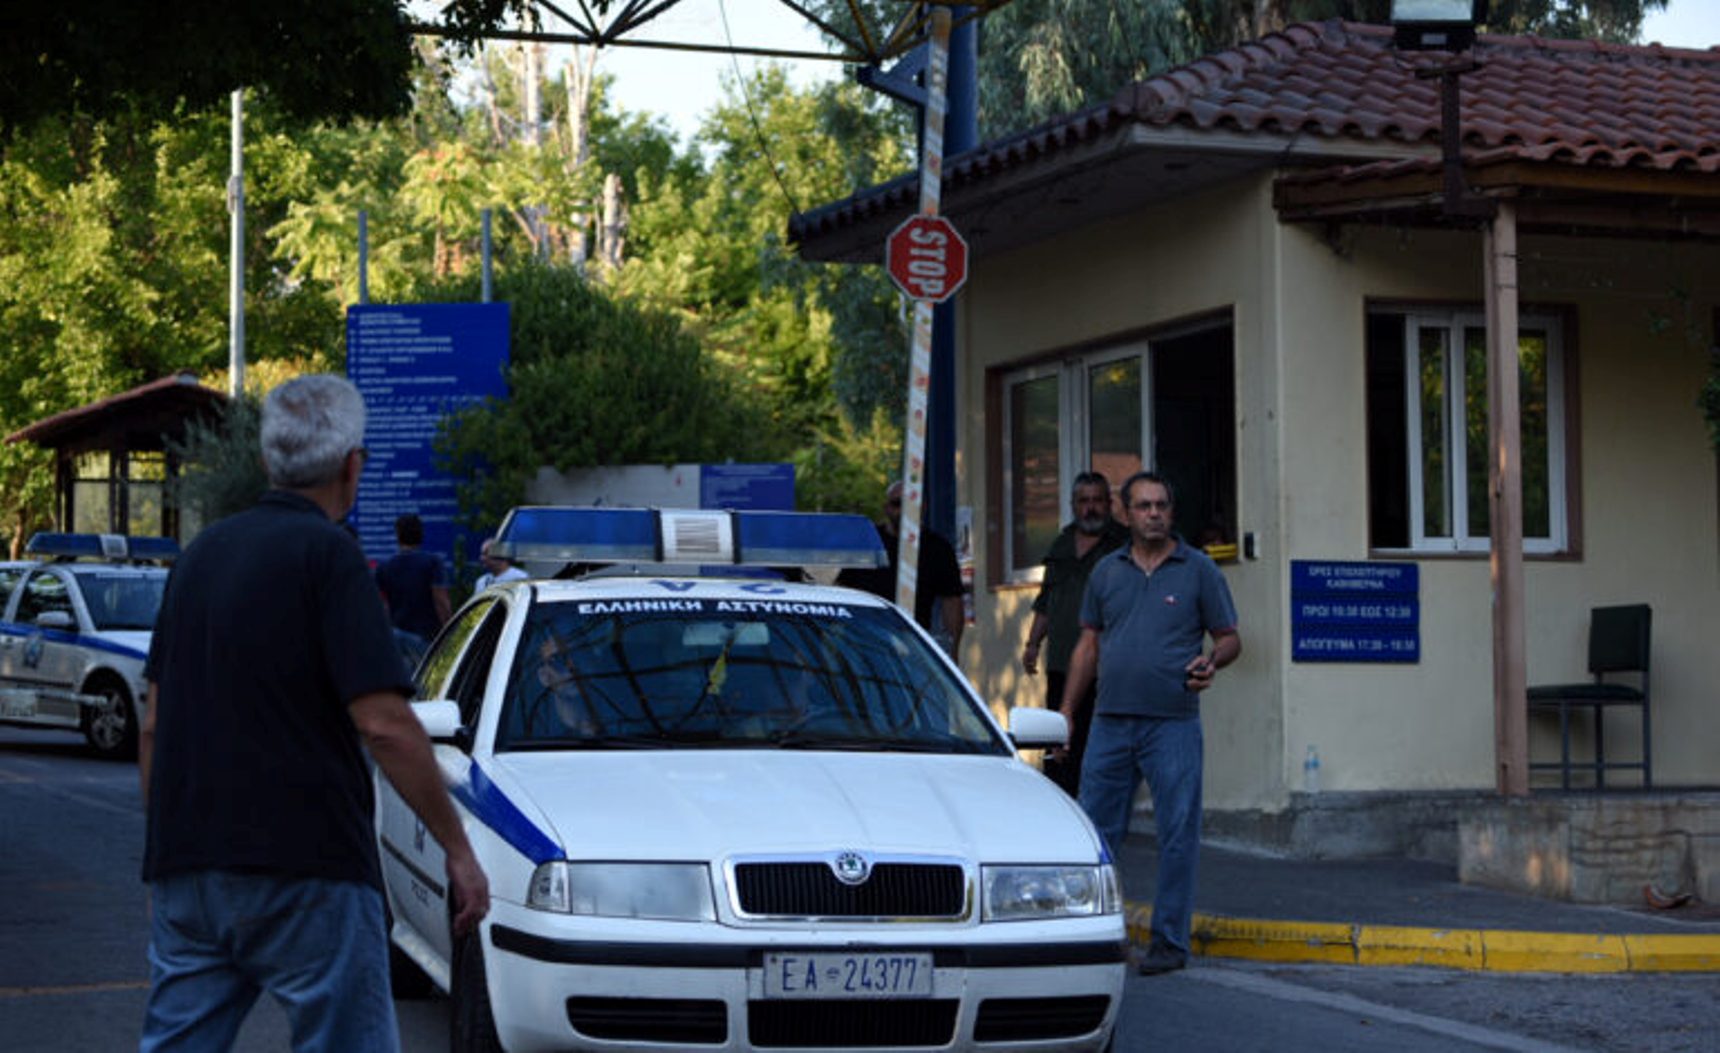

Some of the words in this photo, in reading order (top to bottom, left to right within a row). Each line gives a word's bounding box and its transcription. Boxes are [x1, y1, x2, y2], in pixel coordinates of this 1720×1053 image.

[909, 227, 947, 293] STOP
[578, 600, 702, 614] ΕΛΛΗΝΙΚΗ
[717, 600, 853, 618] ΑΣΤΥΝΟΜΙΑ
[1298, 638, 1356, 651] ΑΠΟΓΕΥΜΑ
